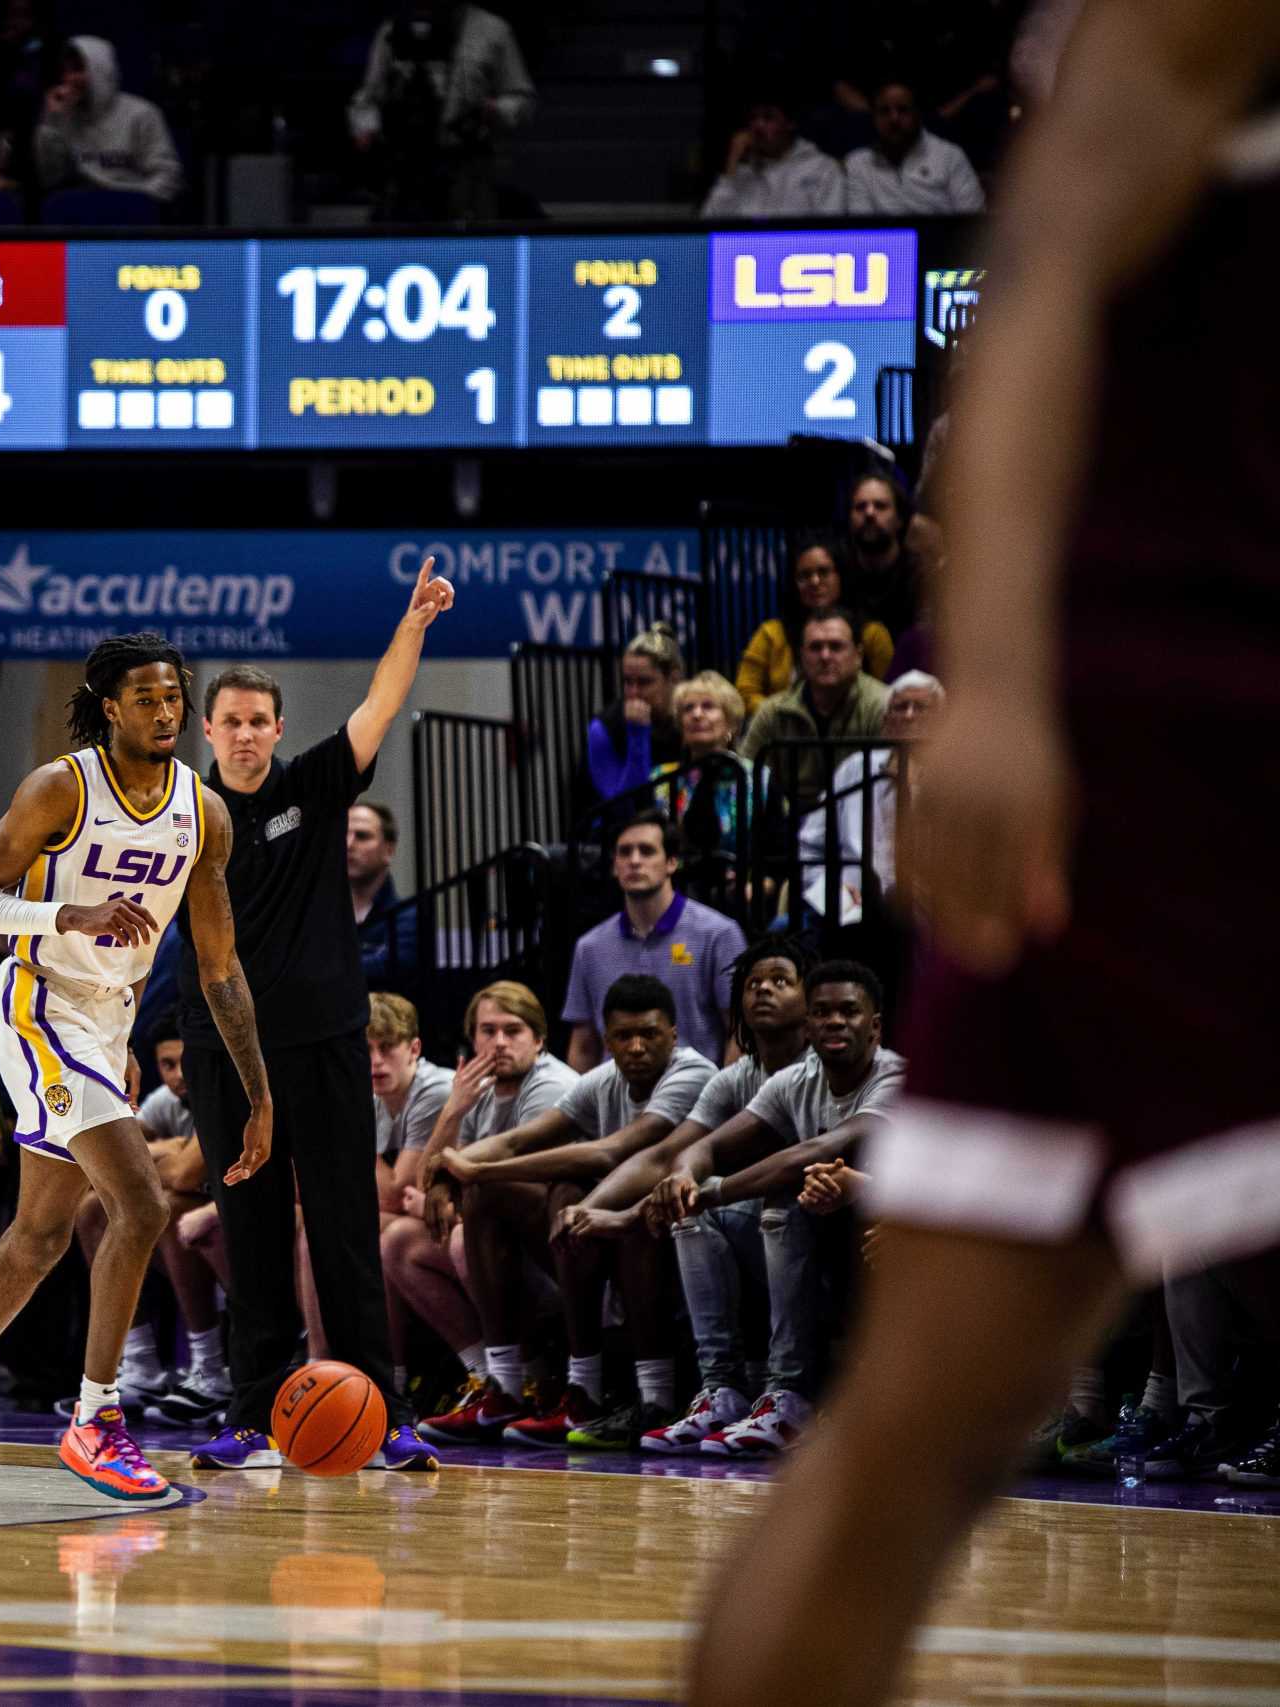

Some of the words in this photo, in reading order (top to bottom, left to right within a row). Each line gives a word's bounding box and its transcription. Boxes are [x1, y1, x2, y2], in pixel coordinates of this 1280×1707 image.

[118, 265, 201, 291] FOULS
[575, 260, 658, 286] FOULS
[735, 254, 888, 308] LSU
[145, 288, 188, 341] 0
[278, 264, 495, 342] 17:04
[603, 286, 642, 339] 2
[91, 358, 154, 384] TIME
[155, 358, 226, 384] OUTS
[547, 354, 610, 381] TIME
[611, 353, 682, 381] OUTS
[802, 342, 857, 419] 2
[290, 377, 434, 415] PERIOD
[465, 368, 496, 424] 1
[388, 541, 624, 585] COMFORT
[38, 563, 295, 628] accutemp
[82, 843, 187, 887] LSU
[282, 1377, 317, 1418] LSU
